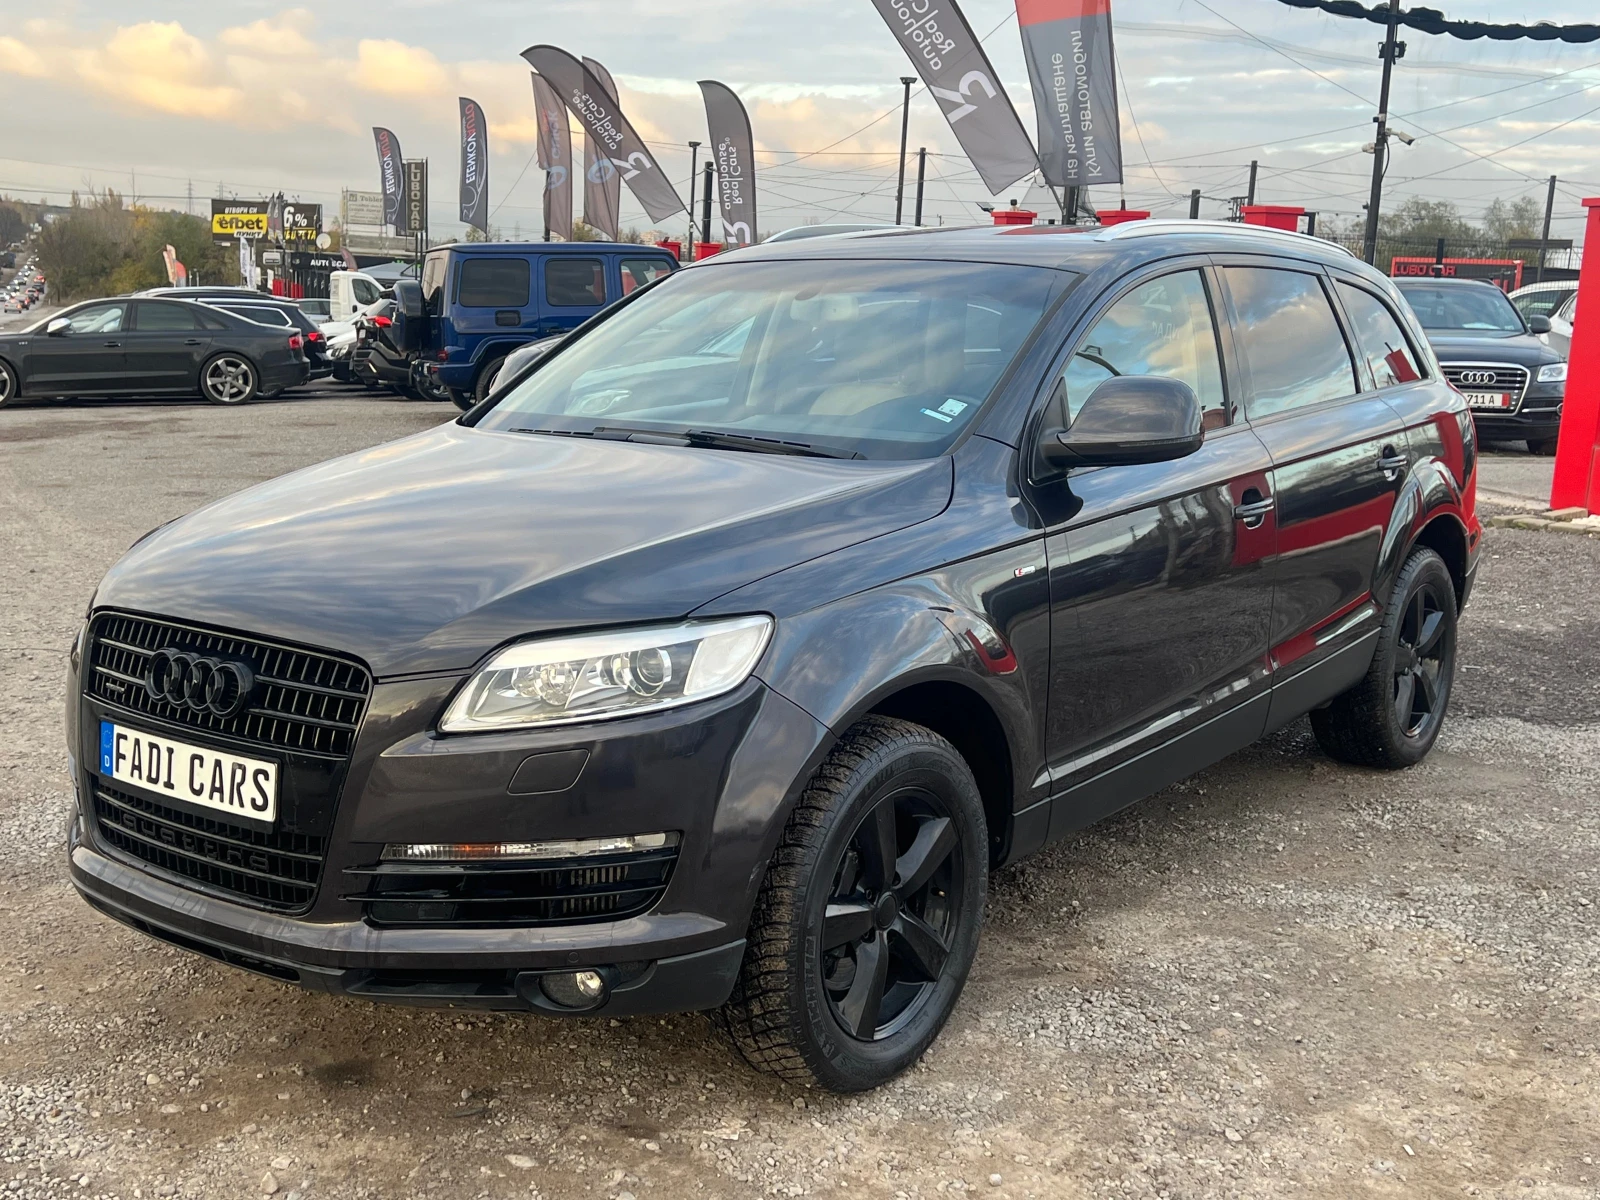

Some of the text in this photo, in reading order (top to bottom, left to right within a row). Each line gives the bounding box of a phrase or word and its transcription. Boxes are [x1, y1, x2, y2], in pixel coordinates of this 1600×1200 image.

[410, 163, 420, 229] LUBO CAR
[217, 216, 264, 230] efbet
[1395, 265, 1427, 276] LUBO
[1488, 395, 1495, 405] A
[115, 732, 175, 790] FADI
[188, 753, 270, 812] CARS
[123, 813, 270, 873] quattro
